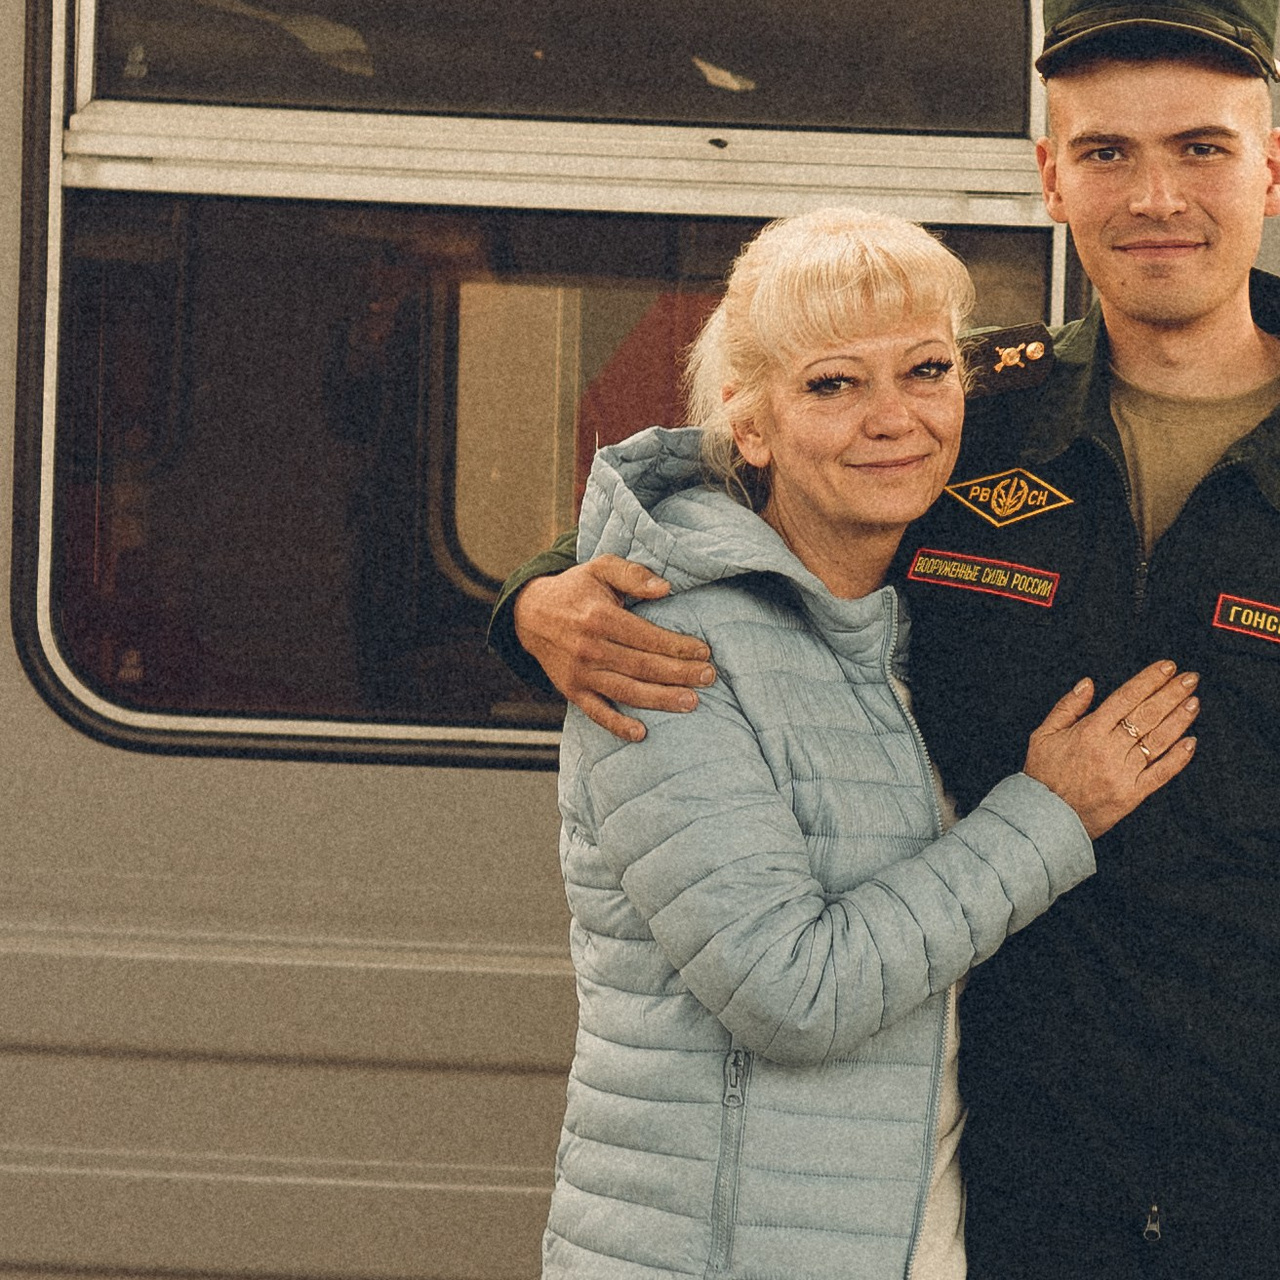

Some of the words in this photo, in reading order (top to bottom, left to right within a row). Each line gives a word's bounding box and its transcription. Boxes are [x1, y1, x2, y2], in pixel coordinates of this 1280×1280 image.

[968, 485, 990, 503] РВ
[1027, 489, 1049, 506] СН
[914, 556, 982, 582] ВООРУЖЕННЫЕ
[981, 567, 1010, 587] СИЛЫ
[1011, 573, 1053, 598] РОССИИ
